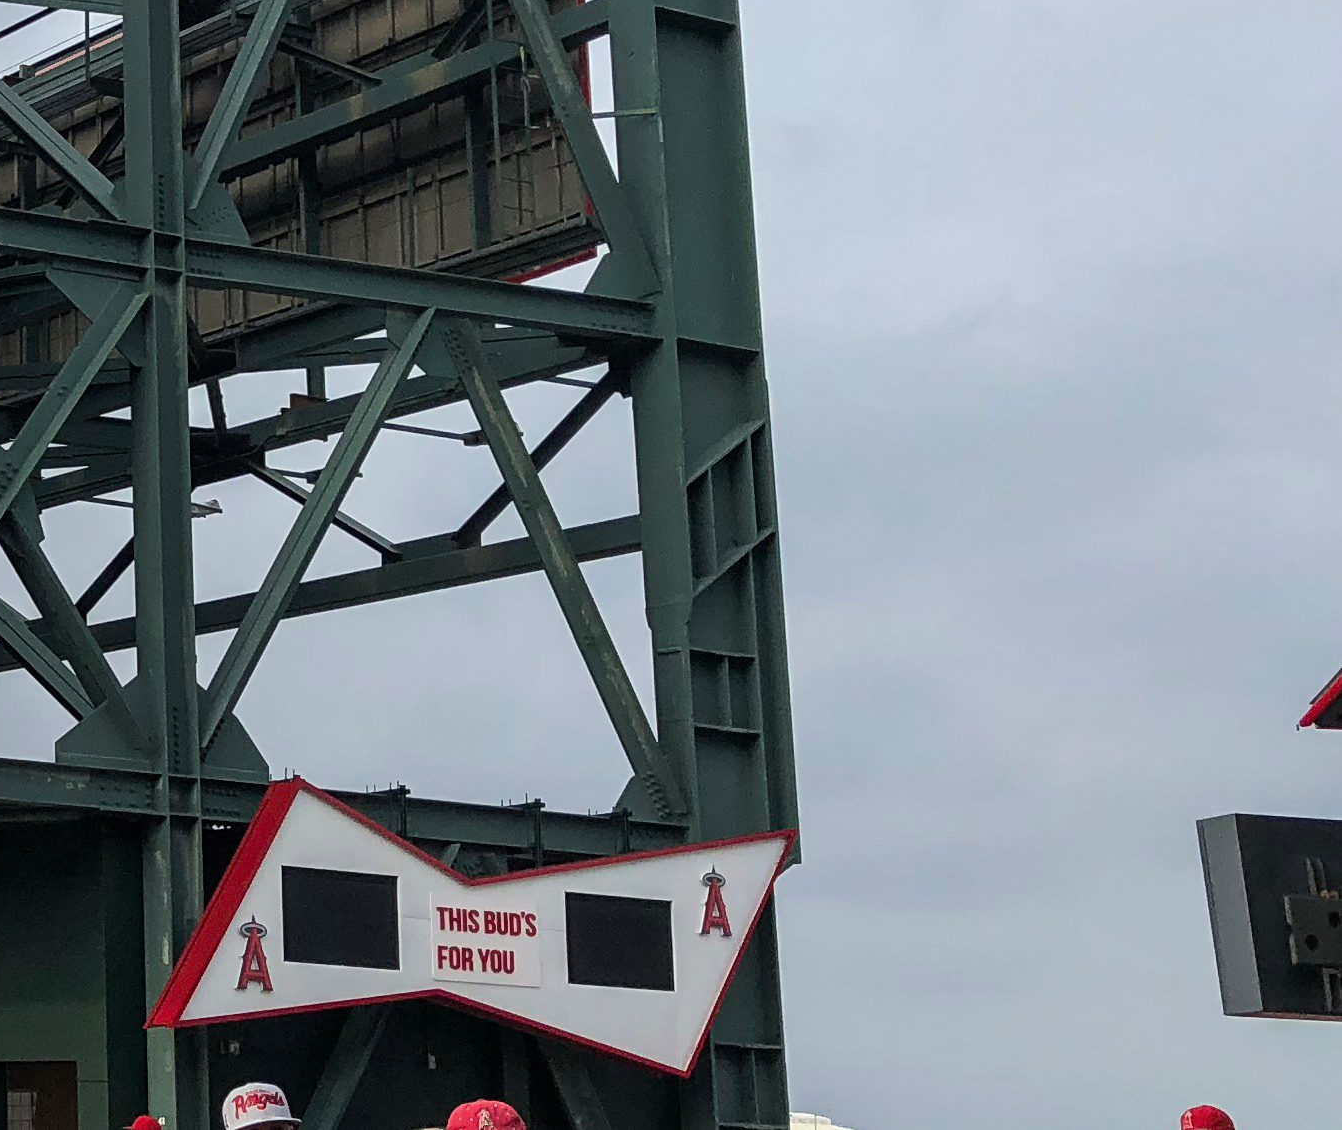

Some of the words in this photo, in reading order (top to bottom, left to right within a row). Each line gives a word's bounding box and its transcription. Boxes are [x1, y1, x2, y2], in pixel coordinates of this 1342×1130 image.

[436, 907, 480, 933] THIS
[484, 911, 537, 937] BUD'S
[437, 945, 474, 972] FOR
[477, 948, 515, 974] YOU
